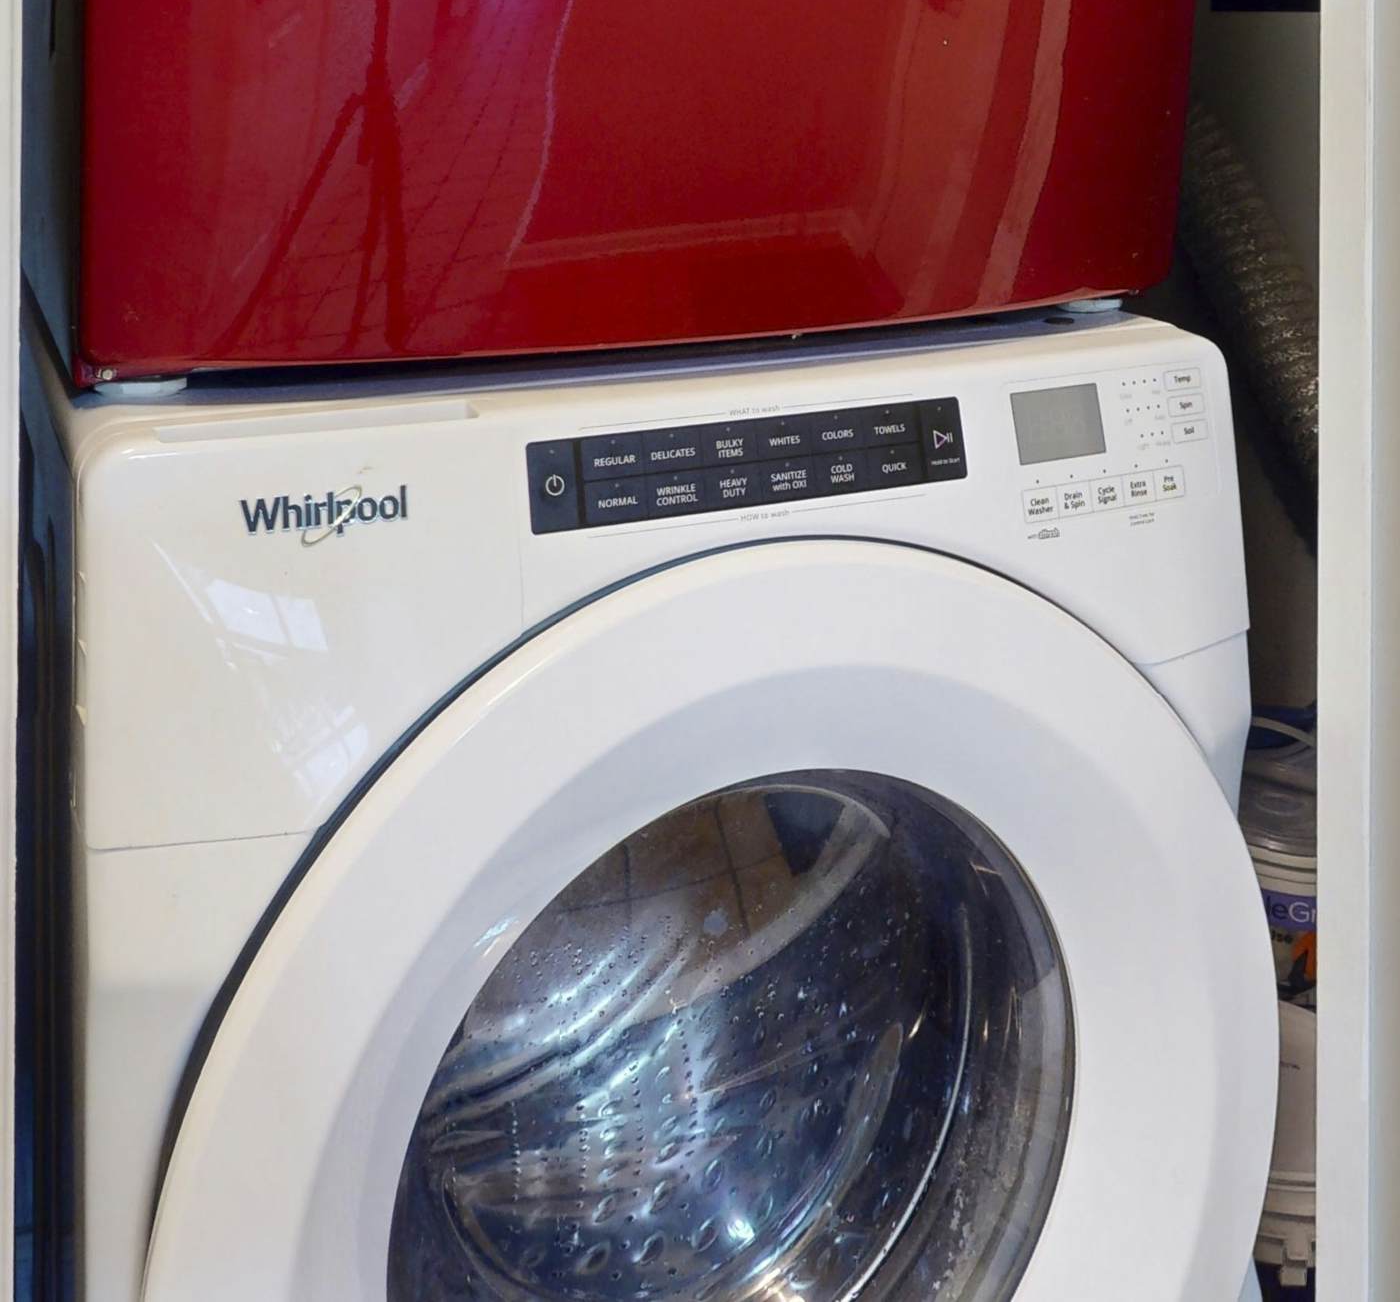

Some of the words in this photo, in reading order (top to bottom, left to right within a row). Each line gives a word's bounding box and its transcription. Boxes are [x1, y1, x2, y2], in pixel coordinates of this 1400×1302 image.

[1174, 375, 1191, 384] Temp
[1179, 401, 1193, 411] Spin
[821, 429, 854, 441] COLORS
[873, 423, 906, 436] TOWELS
[715, 438, 744, 450] BULKY
[769, 435, 801, 447] WHITES
[650, 447, 696, 461] DELICATES
[717, 448, 744, 459] ITEMS
[593, 454, 636, 467] REGULAR
[830, 463, 853, 475] COLD
[881, 461, 907, 473] QUICK
[770, 469, 807, 483] SANITIZE
[830, 472, 855, 484] WASH
[1163, 475, 1174, 483] Pre
[656, 483, 696, 496] WRINKLE
[719, 478, 748, 489] HEAVY
[772, 480, 791, 492] with
[792, 478, 808, 489] OXI
[1130, 480, 1147, 490] Extra
[1162, 483, 1177, 492] Soak
[722, 487, 746, 499] DUTY
[1064, 491, 1083, 501] Drain
[1097, 485, 1115, 496] Cycle
[1131, 488, 1148, 499] Rinse
[597, 496, 638, 509] NORMAL
[656, 494, 698, 507] CONTROL
[1030, 497, 1050, 507] Clean
[1070, 500, 1086, 509] Spin
[1097, 495, 1117, 505] Signal
[239, 484, 407, 536] Whirlpool
[1028, 505, 1054, 516] Washer
